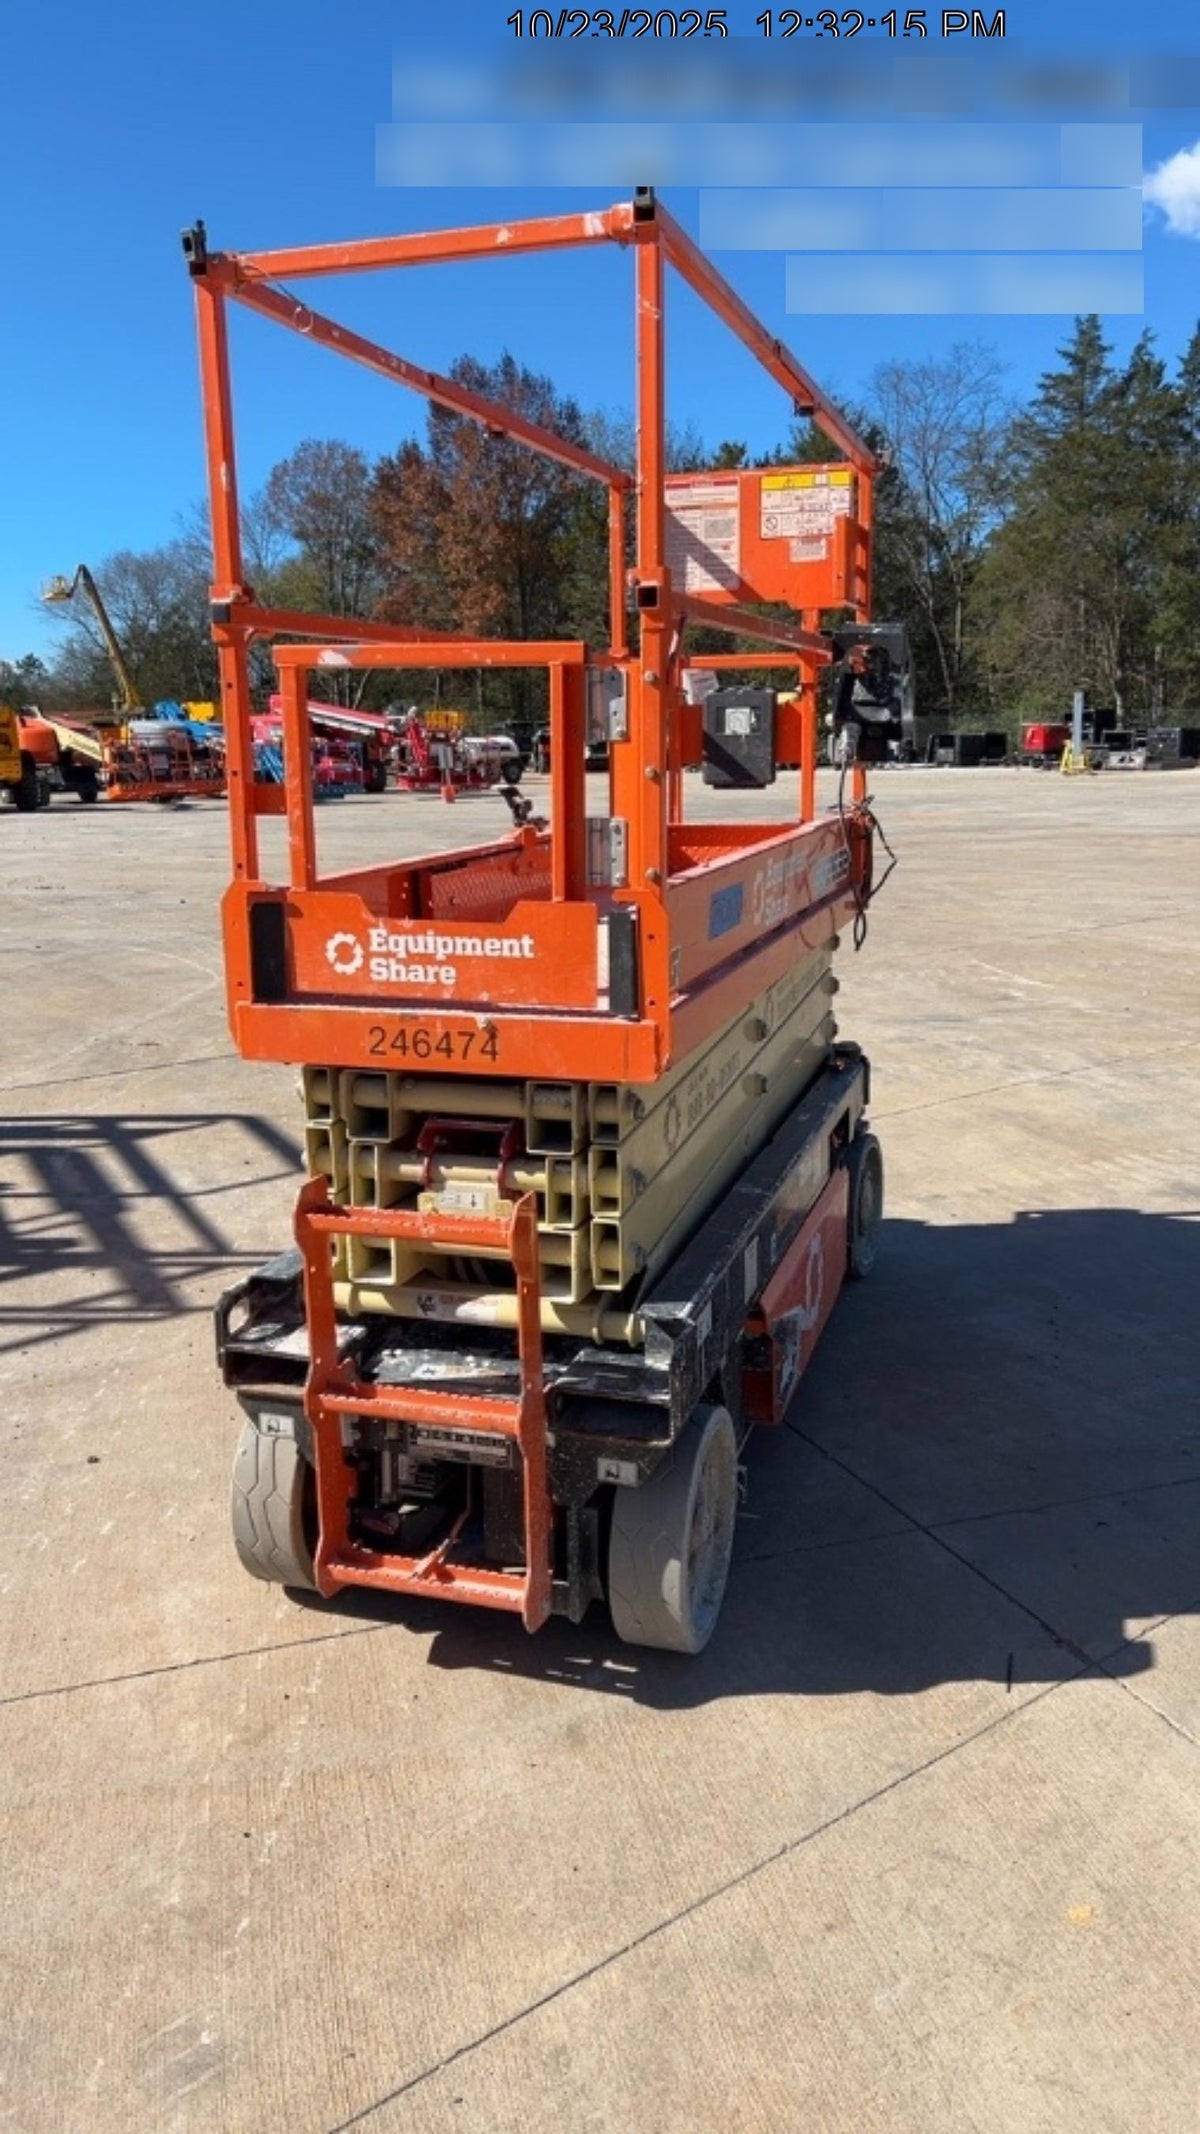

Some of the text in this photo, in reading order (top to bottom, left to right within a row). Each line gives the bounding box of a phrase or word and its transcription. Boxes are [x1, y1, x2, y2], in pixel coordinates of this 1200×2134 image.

[369, 928, 535, 961] Equipment
[369, 957, 457, 985] Share
[368, 1025, 500, 1062] 246474
